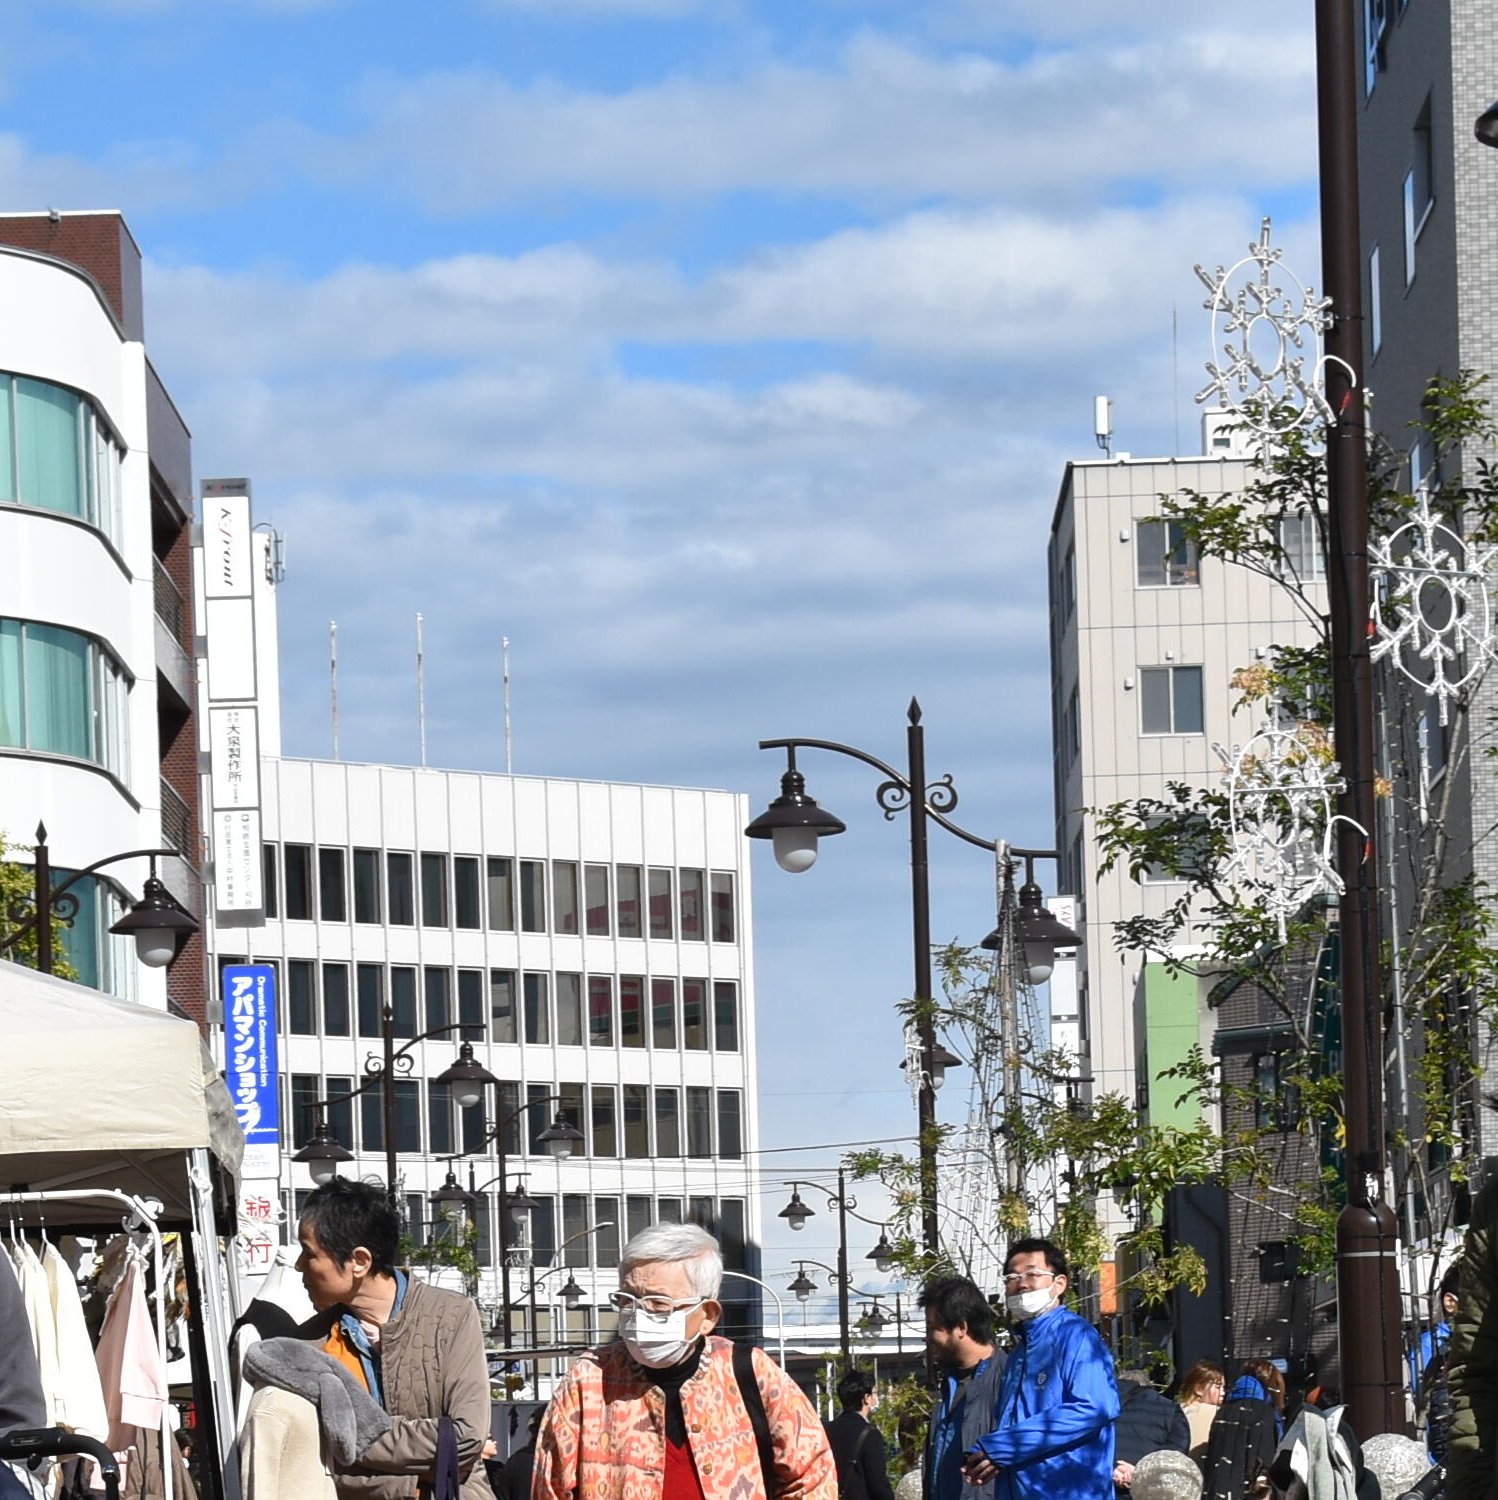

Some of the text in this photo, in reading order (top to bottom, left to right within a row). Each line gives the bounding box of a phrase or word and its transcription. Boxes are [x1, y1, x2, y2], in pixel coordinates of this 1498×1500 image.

[231, 975, 262, 1135] アパマンショップ
[257, 975, 269, 1087] Dramatic Communication
